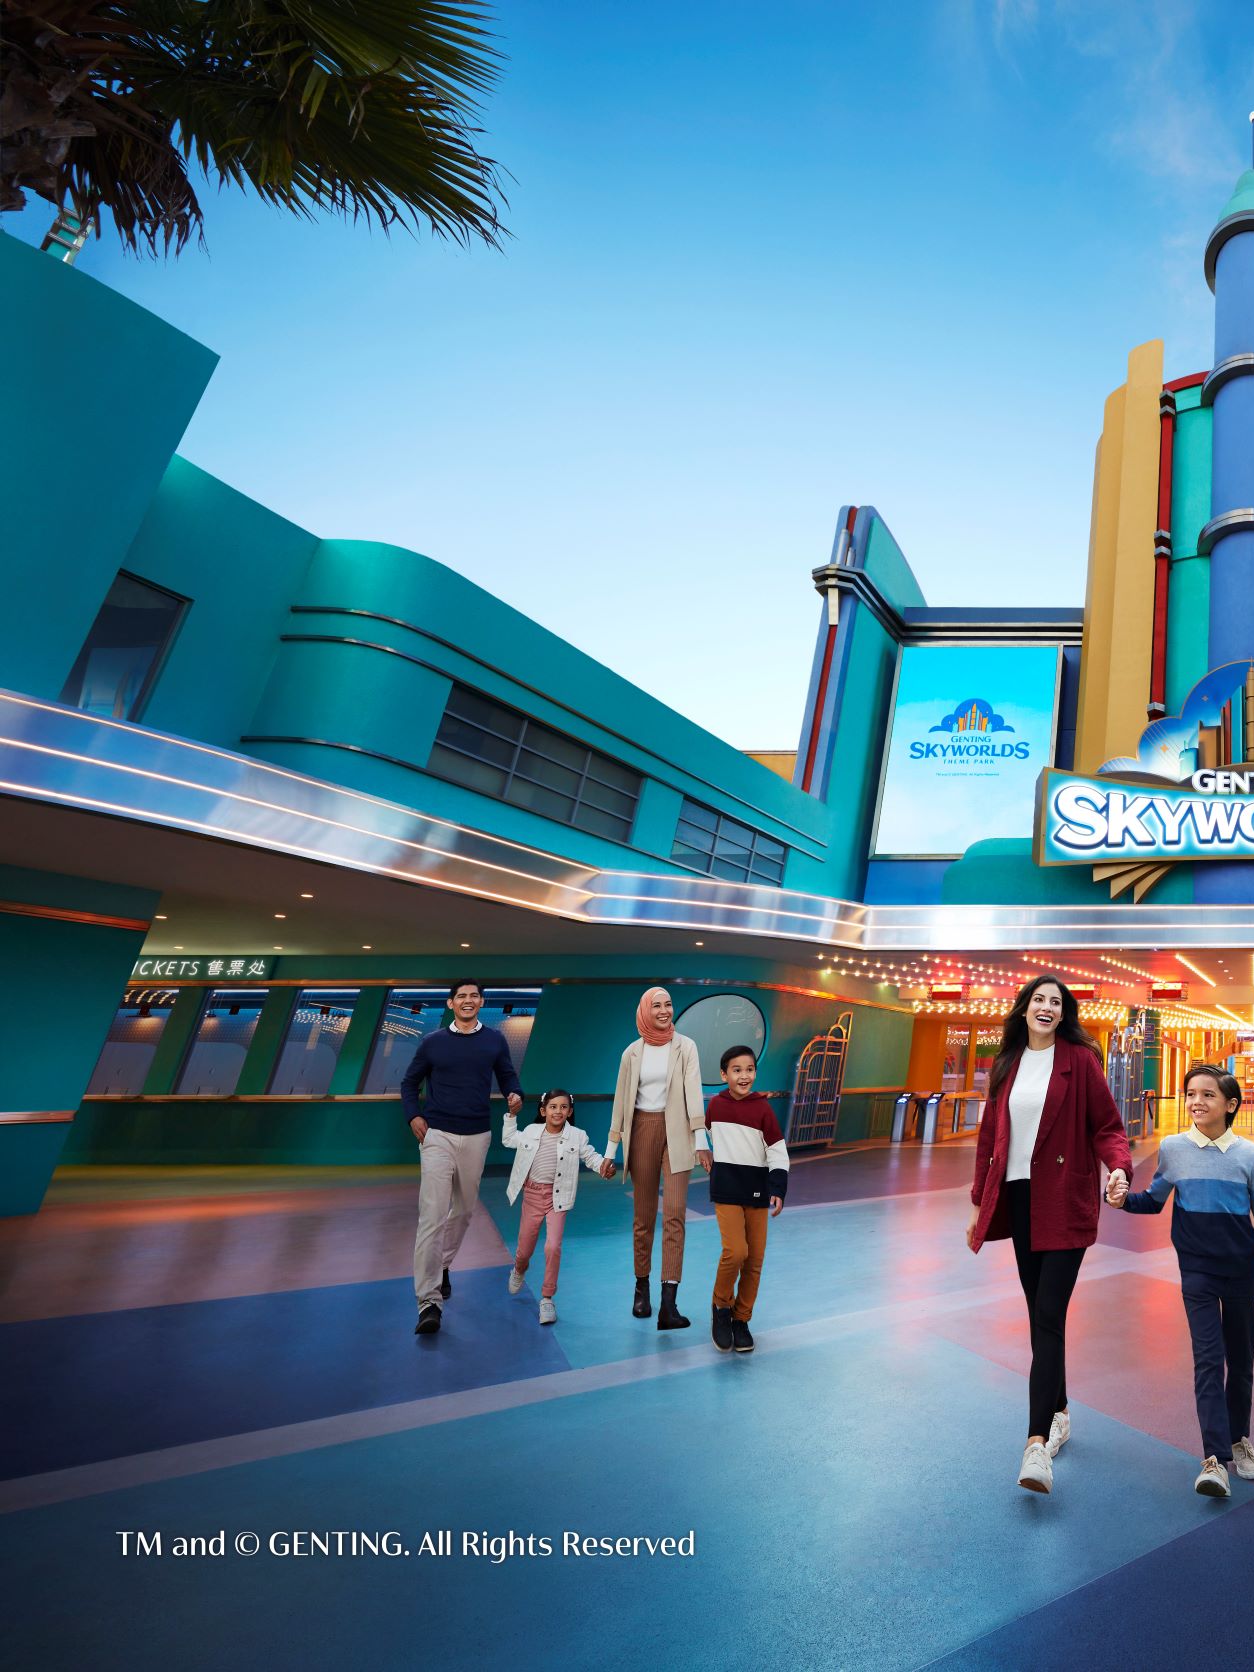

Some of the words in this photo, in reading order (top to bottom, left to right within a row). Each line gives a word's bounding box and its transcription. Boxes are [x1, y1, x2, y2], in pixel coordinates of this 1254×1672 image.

[950, 735, 992, 743] GENTING
[909, 741, 1030, 760] SKYWORLDS
[131, 960, 200, 976] ICKETS
[207, 959, 265, 976] 售票处
